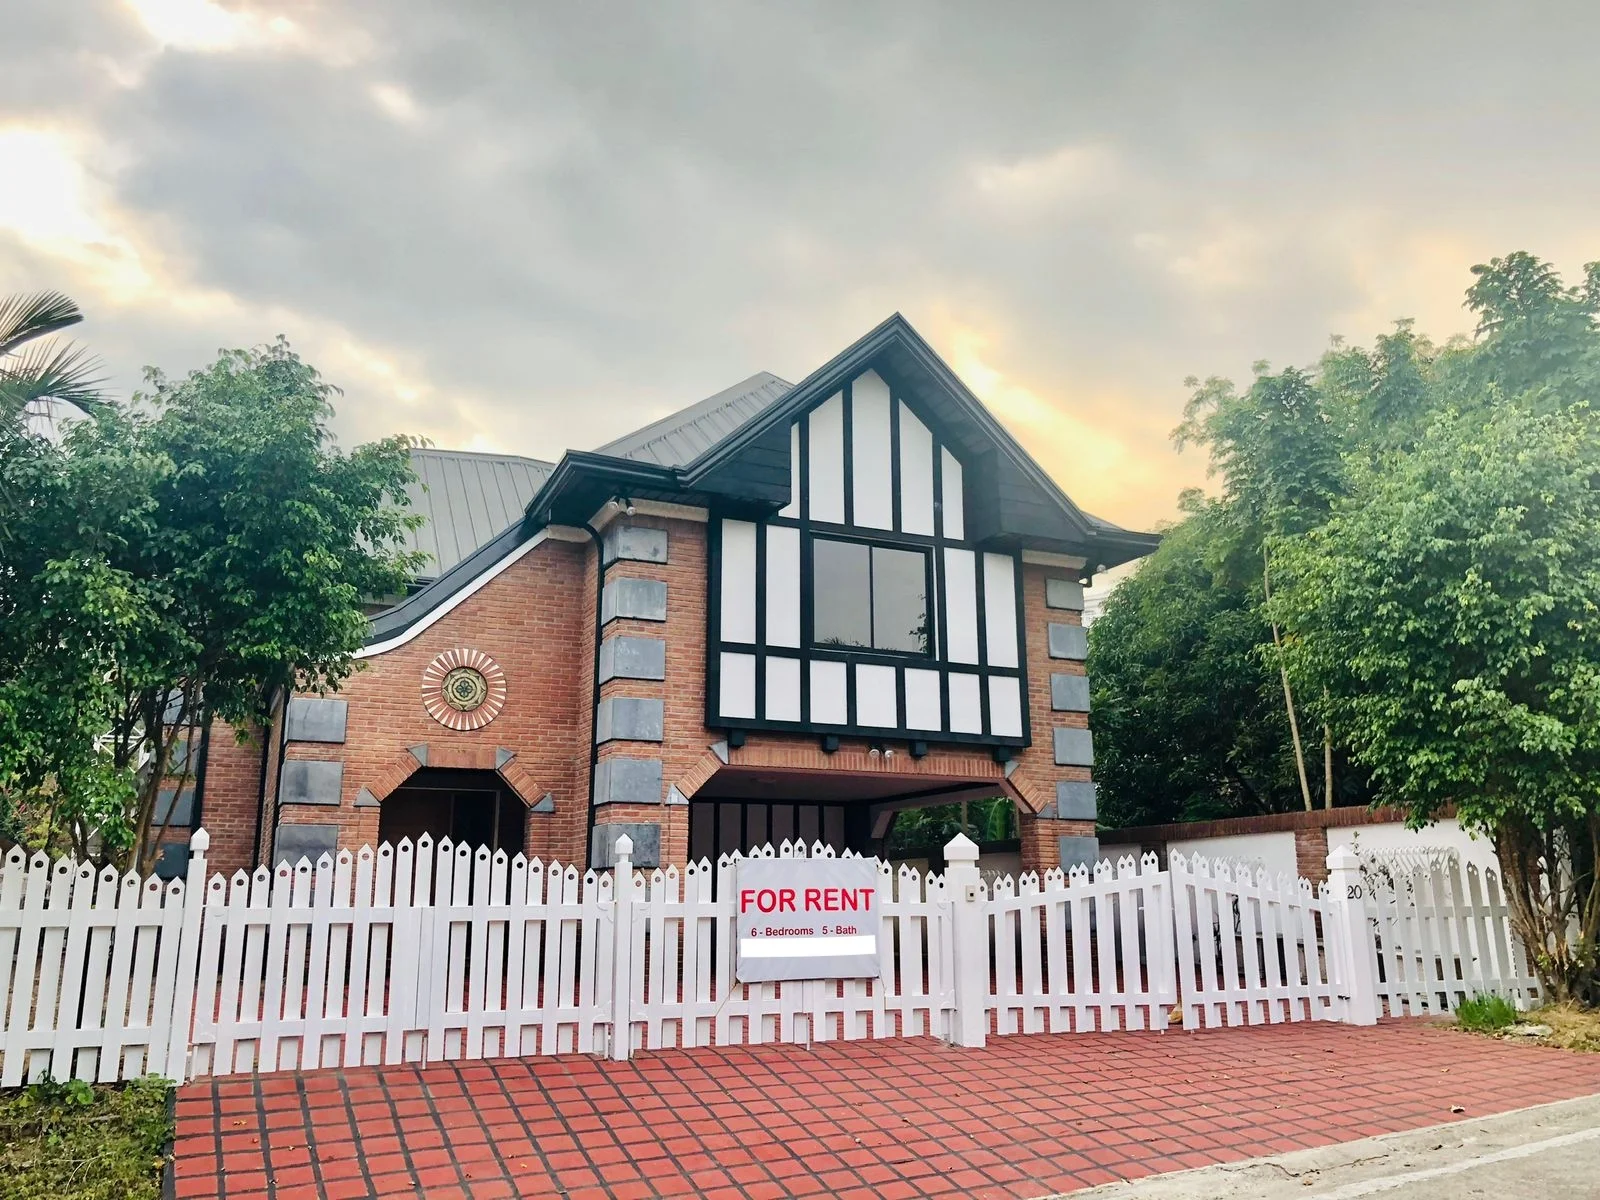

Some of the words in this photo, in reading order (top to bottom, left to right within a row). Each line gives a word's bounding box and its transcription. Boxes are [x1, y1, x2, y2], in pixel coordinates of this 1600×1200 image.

[1347, 885, 1362, 899] 20
[740, 889, 796, 913] FOR
[804, 888, 875, 912] RENT
[750, 927, 757, 937] 6
[765, 926, 814, 936] Bedrooms
[822, 925, 828, 935] 5
[836, 925, 857, 935] Bath
